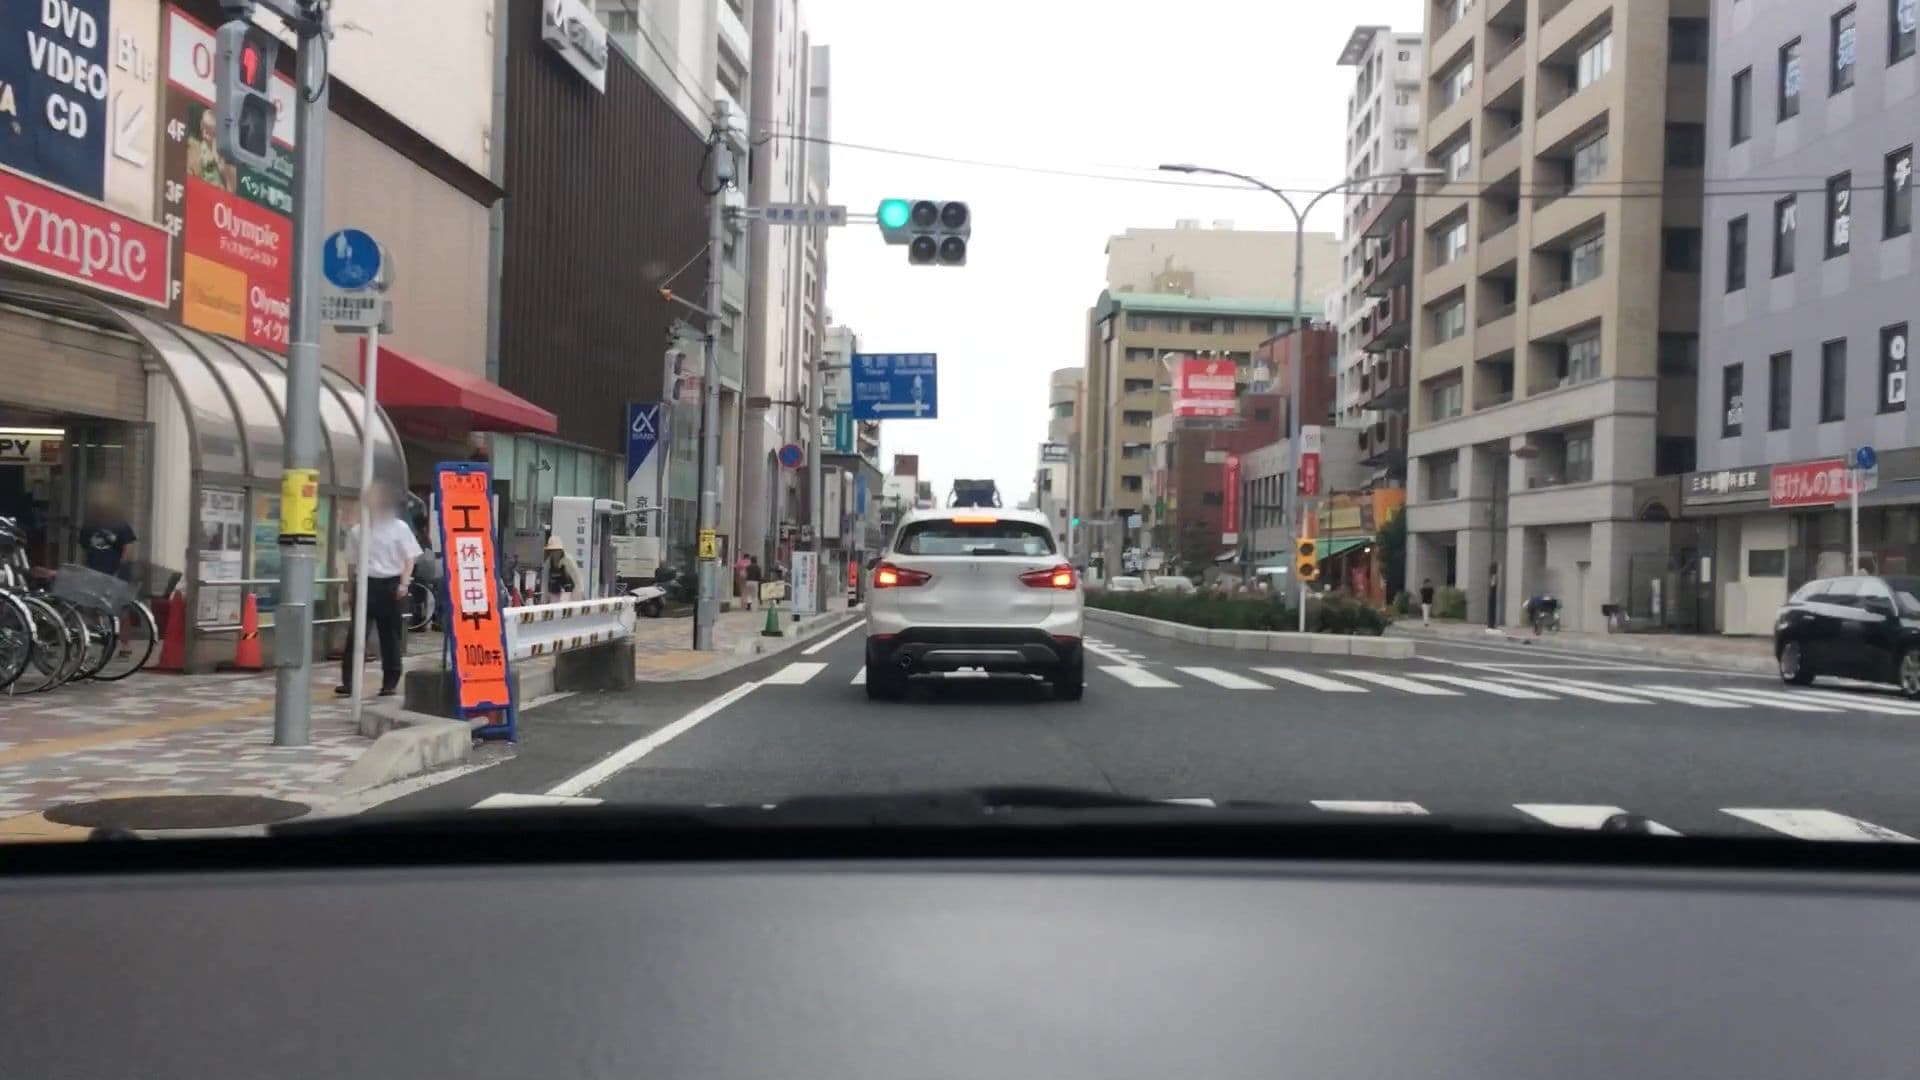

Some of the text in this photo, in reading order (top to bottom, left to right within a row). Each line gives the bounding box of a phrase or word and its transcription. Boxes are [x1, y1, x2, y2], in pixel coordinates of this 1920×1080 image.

[41, 0, 98, 48] DVD
[27, 30, 108, 101] VIDEO
[46, 93, 88, 139] CD
[167, 118, 186, 142] 4F
[165, 180, 184, 204] 3F
[0, 193, 147, 284] ympic
[213, 202, 280, 250] Olympic
[460, 543, 484, 605] 休工中
